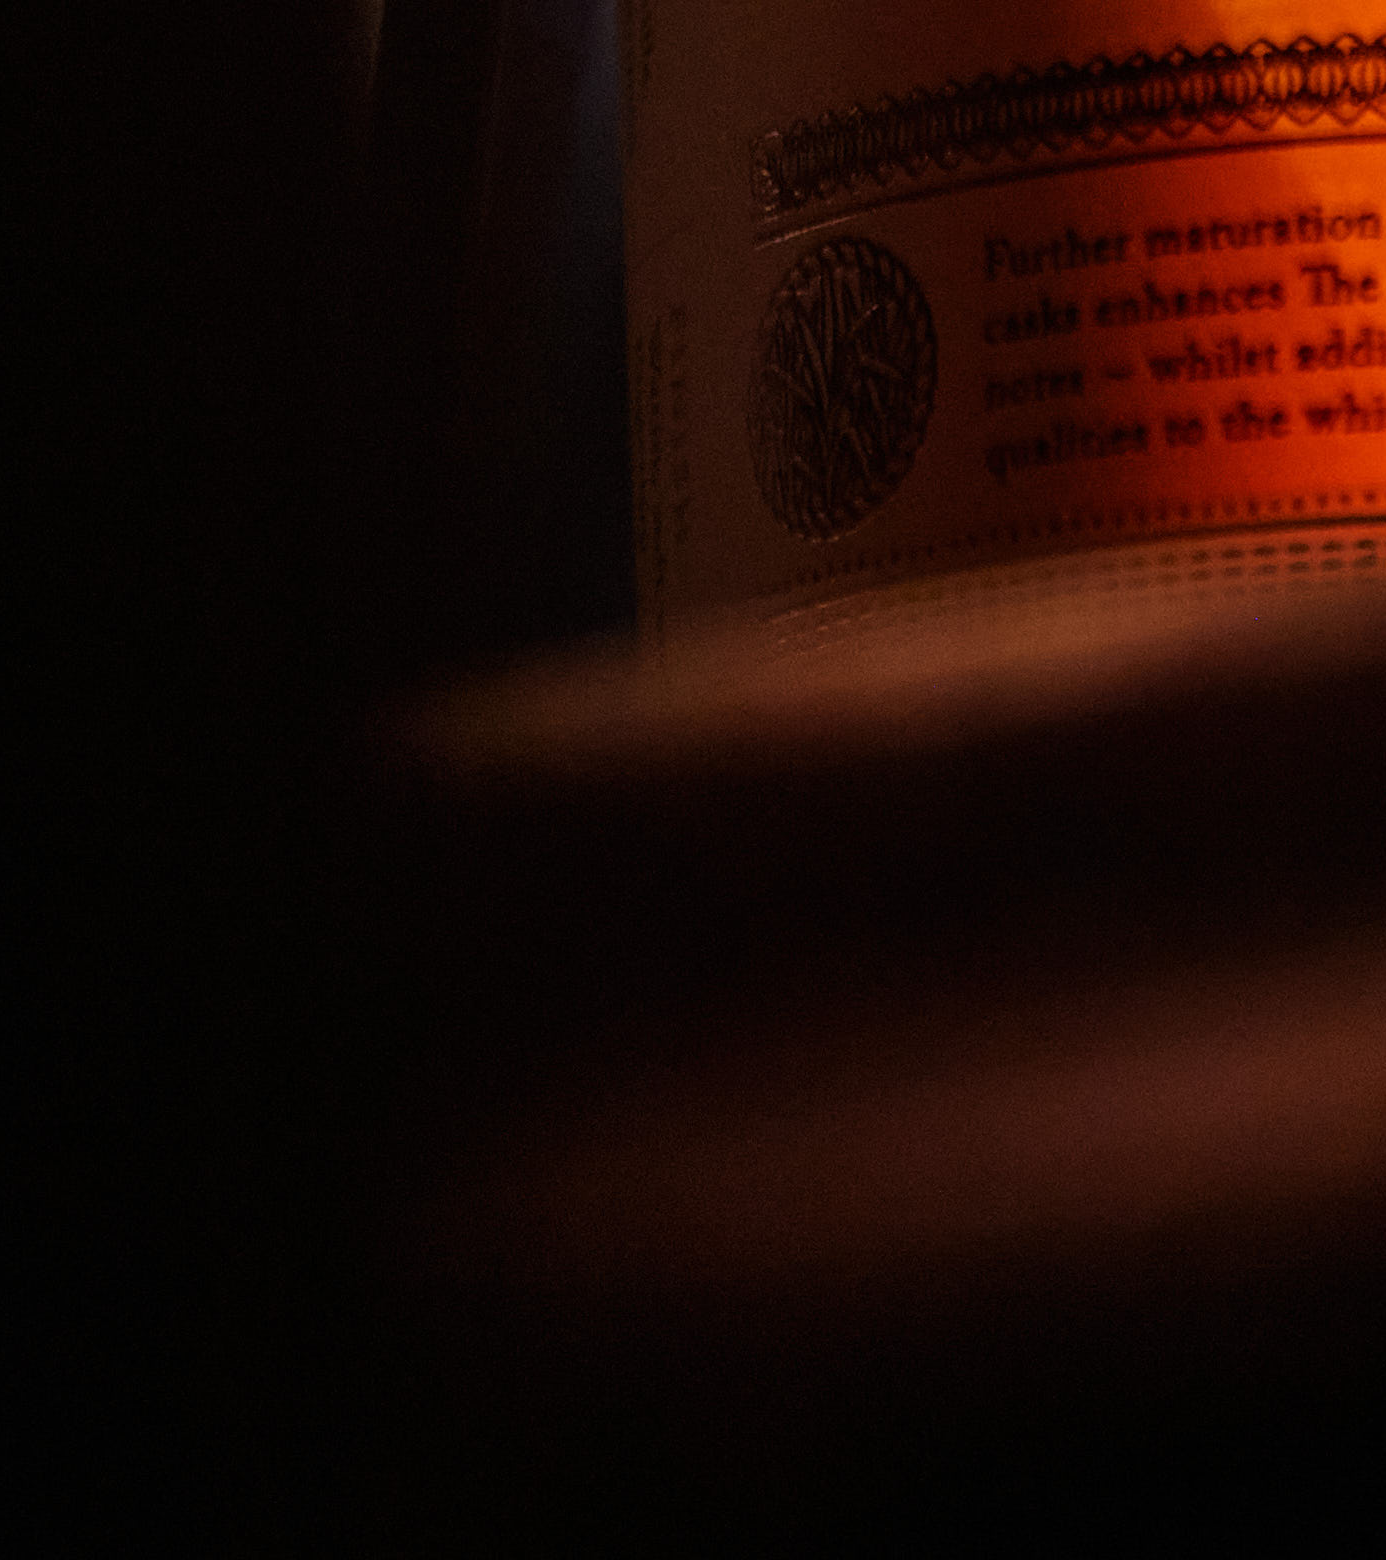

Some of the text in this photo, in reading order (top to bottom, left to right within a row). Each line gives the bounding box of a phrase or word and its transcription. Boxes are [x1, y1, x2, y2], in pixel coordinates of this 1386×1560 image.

[983, 230, 1131, 282] Further
[1144, 204, 1381, 260] maturation
[1093, 280, 1287, 328] enhances
[1299, 261, 1379, 308] The
[1147, 330, 1281, 381] whilst
[1220, 398, 1291, 444] the
